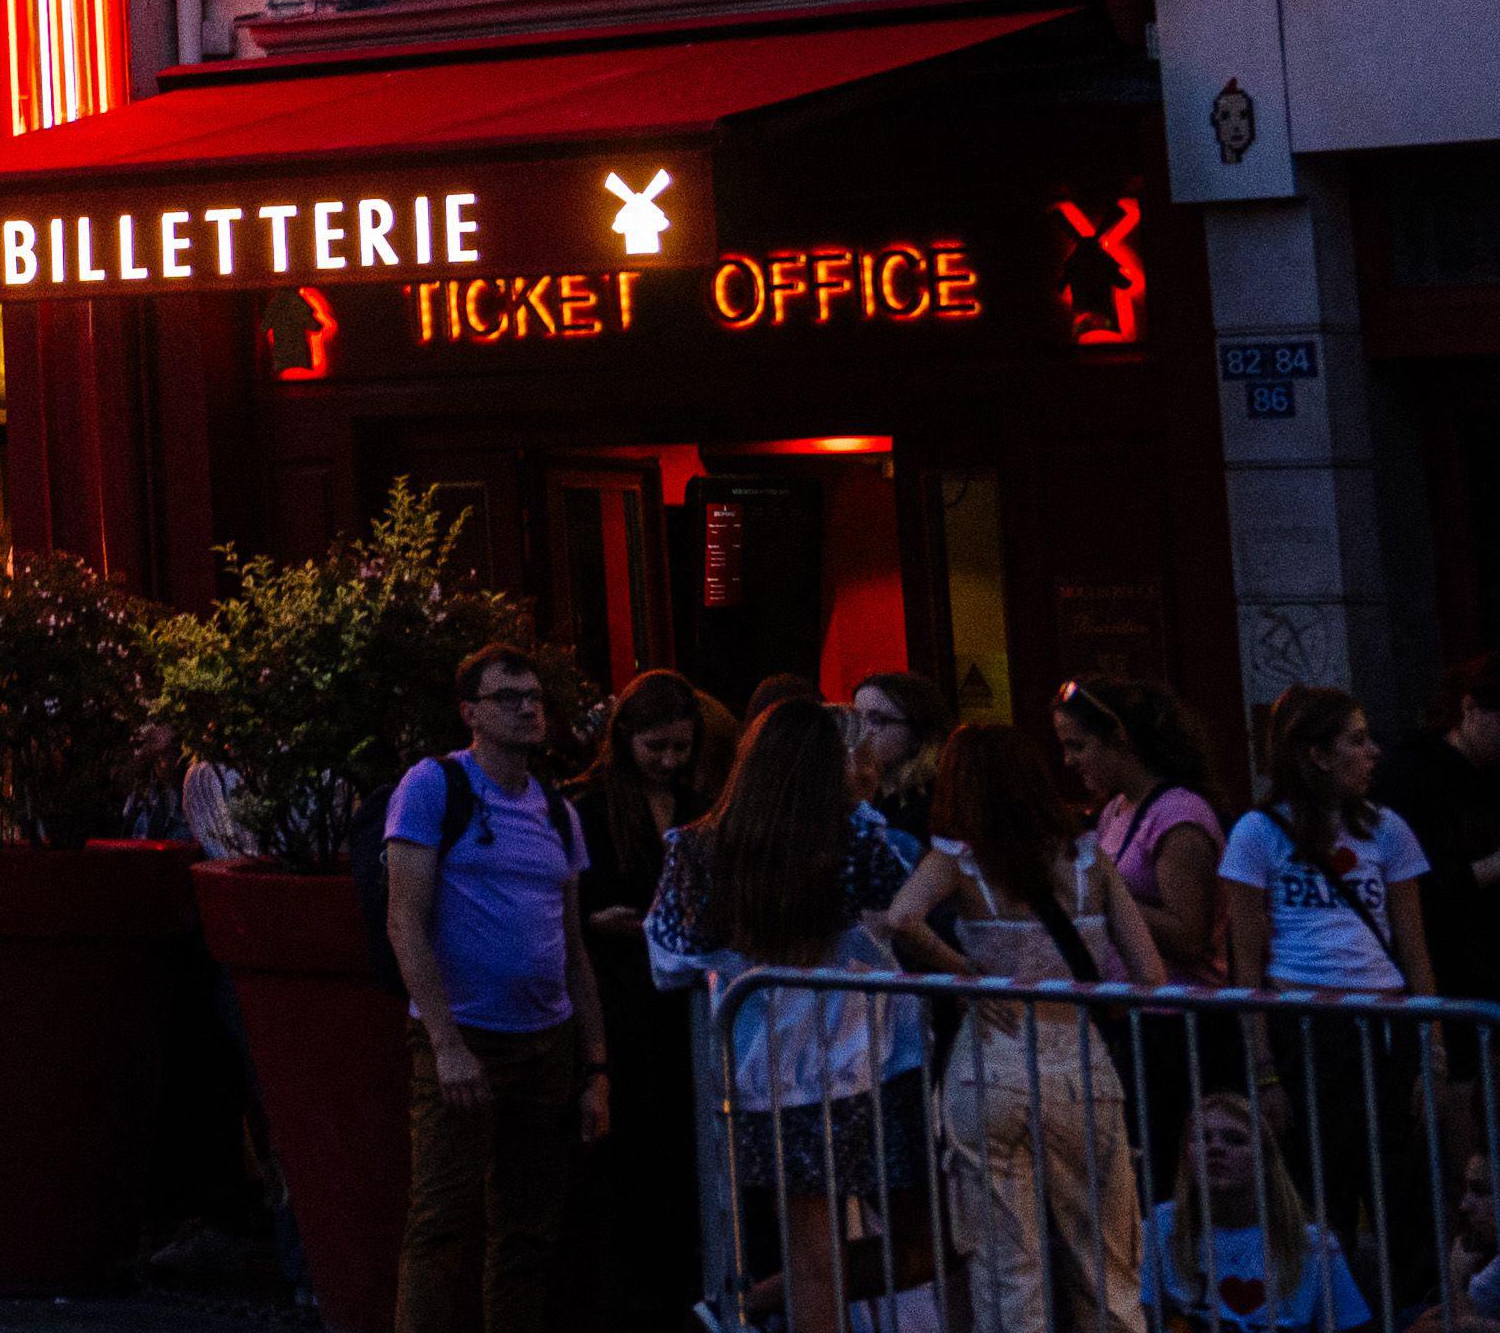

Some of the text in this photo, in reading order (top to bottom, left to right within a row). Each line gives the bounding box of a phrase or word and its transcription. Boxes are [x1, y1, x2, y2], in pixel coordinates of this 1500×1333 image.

[2, 192, 481, 286] BILLETTERIE
[404, 239, 984, 344] TICKET OFFICE
[1227, 347, 1309, 375] 82 84
[1254, 386, 1288, 412] 86
[1281, 876, 1383, 910] PAS
